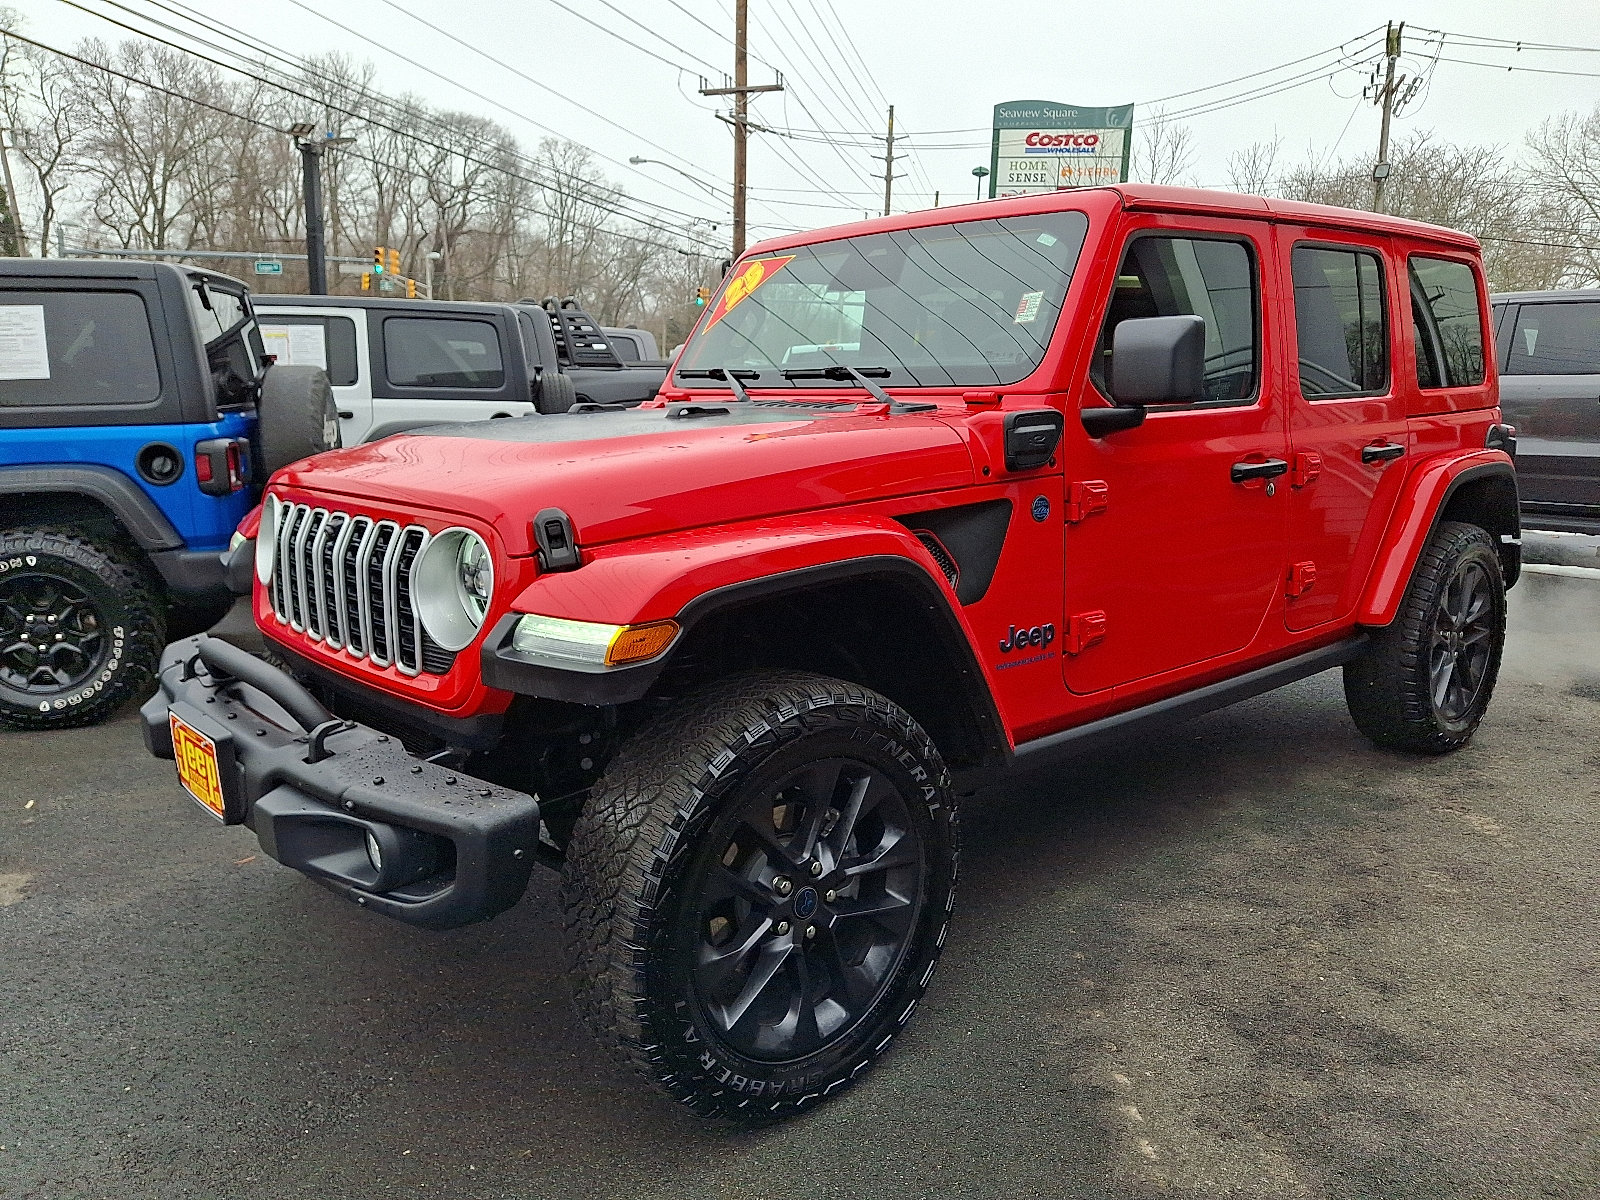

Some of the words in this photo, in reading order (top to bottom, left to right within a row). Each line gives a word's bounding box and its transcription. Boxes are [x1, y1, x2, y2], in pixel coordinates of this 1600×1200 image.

[999, 107, 1040, 118] Seaview
[1043, 107, 1079, 120] Square
[1025, 132, 1099, 147] COSTCO
[1009, 161, 1048, 171] HOME
[1077, 167, 1118, 177] SIERRA
[1008, 173, 1046, 183] SENSE
[999, 622, 1055, 652] Jeep
[54, 625, 125, 709] Firestone
[177, 726, 218, 804] Jeep
[697, 1049, 824, 1097] GRABBER
